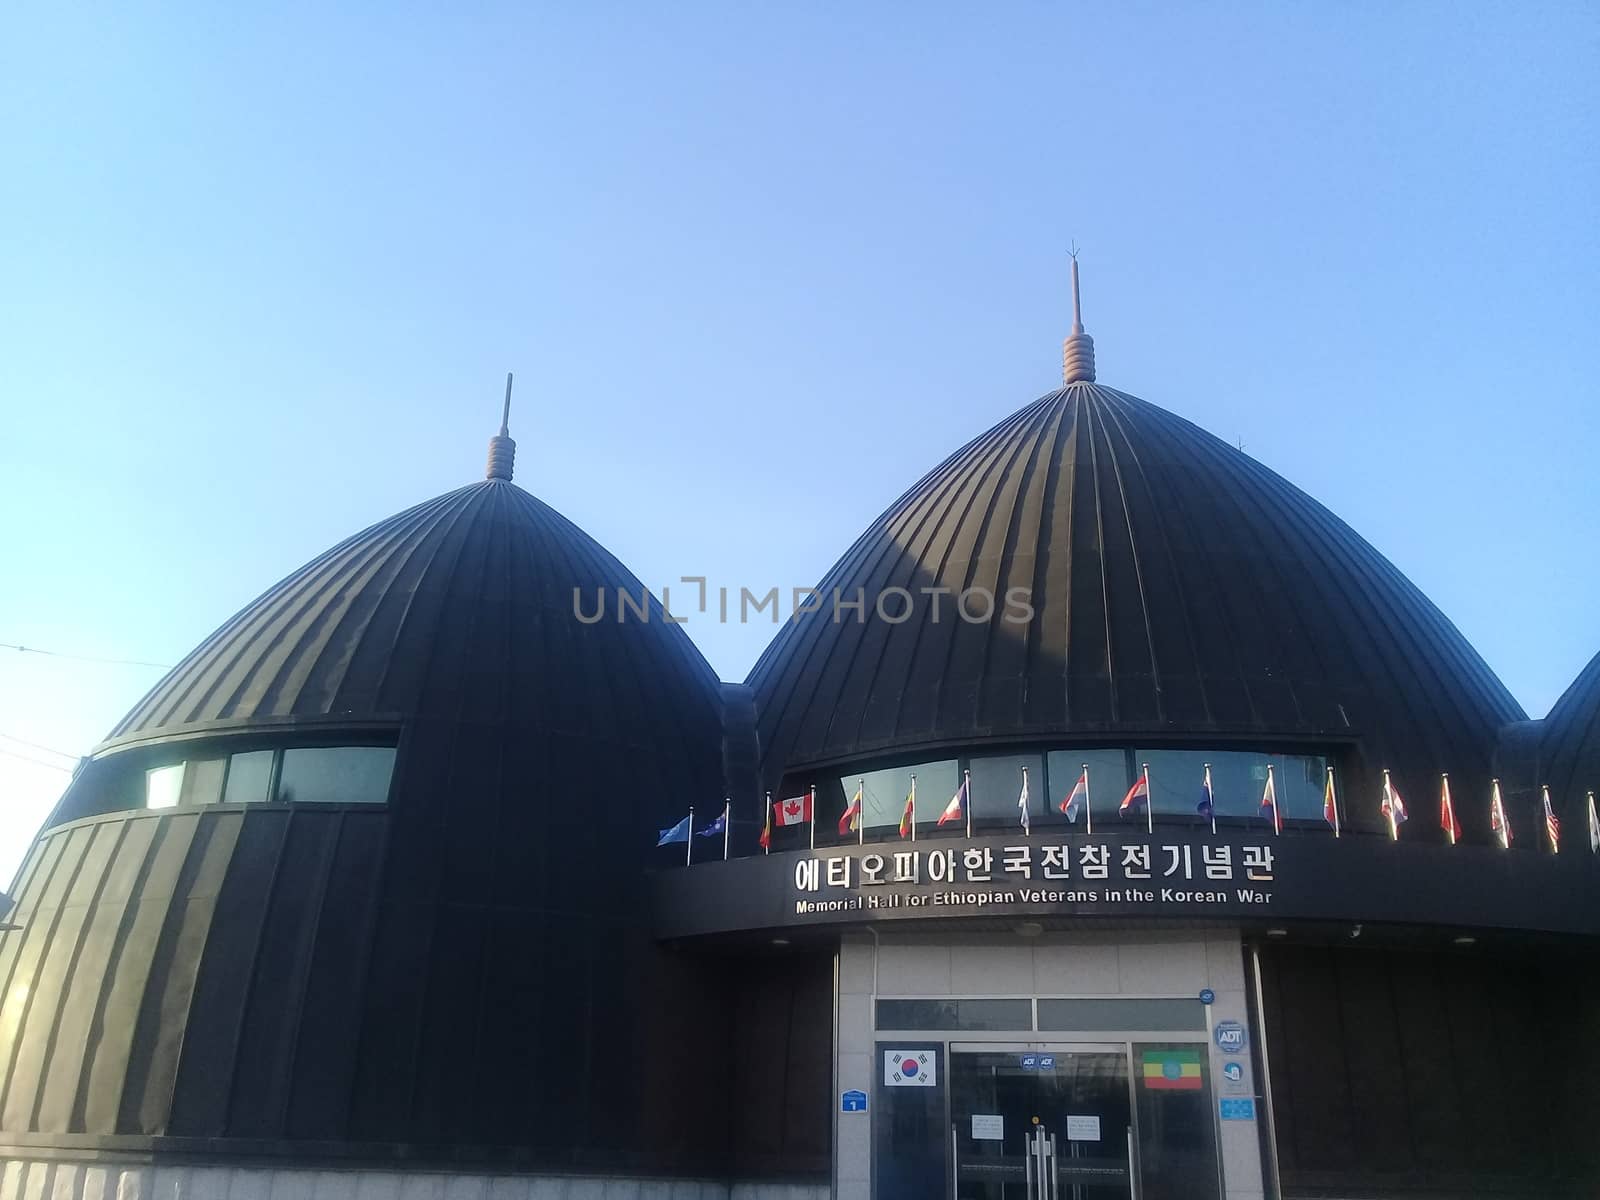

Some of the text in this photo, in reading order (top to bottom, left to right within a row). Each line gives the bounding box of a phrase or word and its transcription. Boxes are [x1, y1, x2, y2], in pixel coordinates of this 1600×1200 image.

[795, 845, 1274, 891] 에티오피아한국전참전기념관
[796, 888, 1272, 914] Memorial Hall for Ethiopian Veterans in the Korean War
[1220, 1030, 1241, 1043] ADT
[849, 1101, 857, 1111] 1
